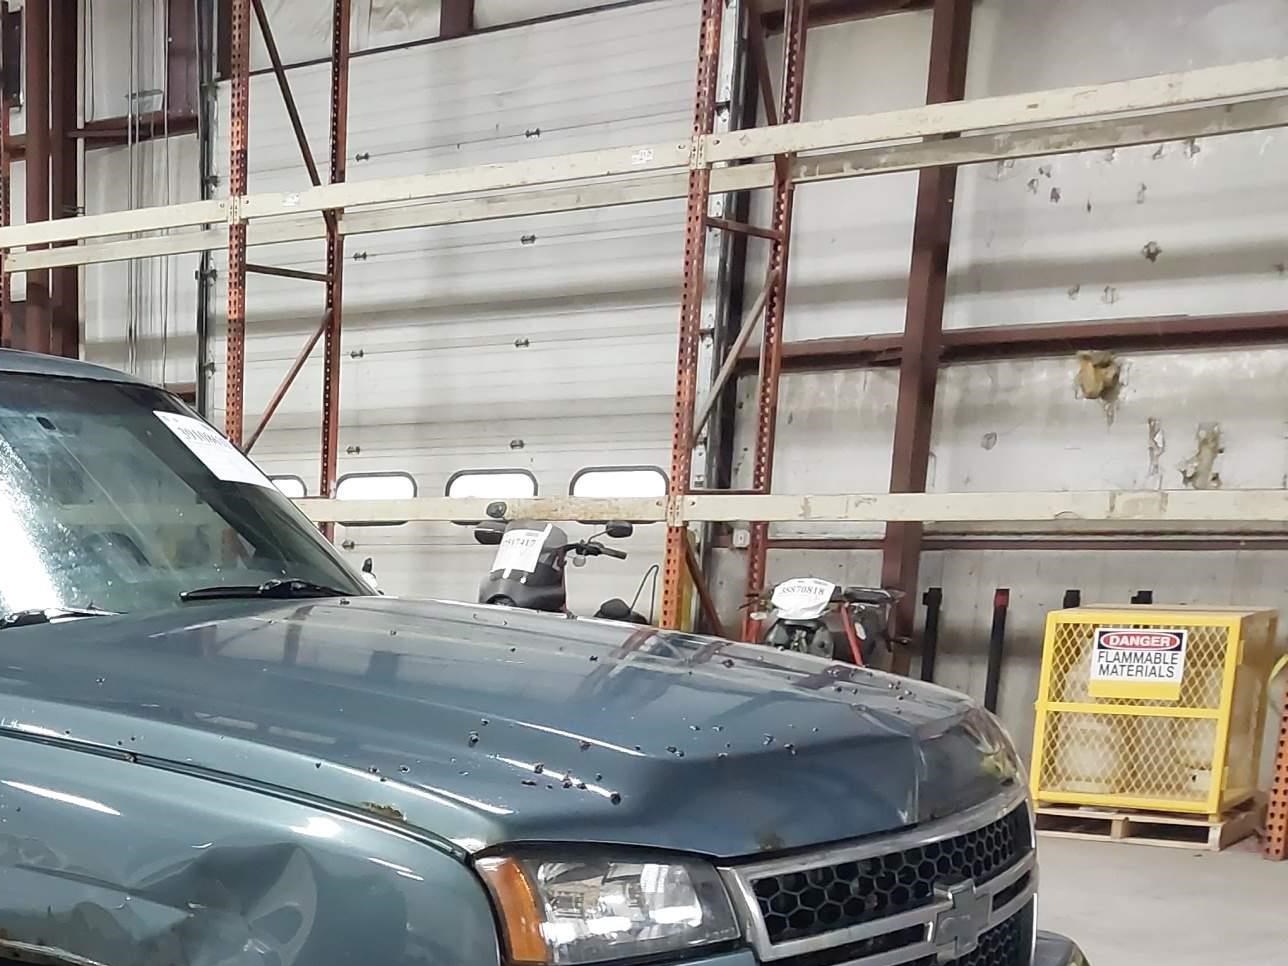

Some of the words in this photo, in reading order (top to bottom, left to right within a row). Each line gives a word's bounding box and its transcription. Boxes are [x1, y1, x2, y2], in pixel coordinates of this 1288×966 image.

[1109, 635, 1171, 647] DANGER
[1098, 650, 1179, 665] FLAMMABLE
[1098, 664, 1175, 678] MATERIALS
